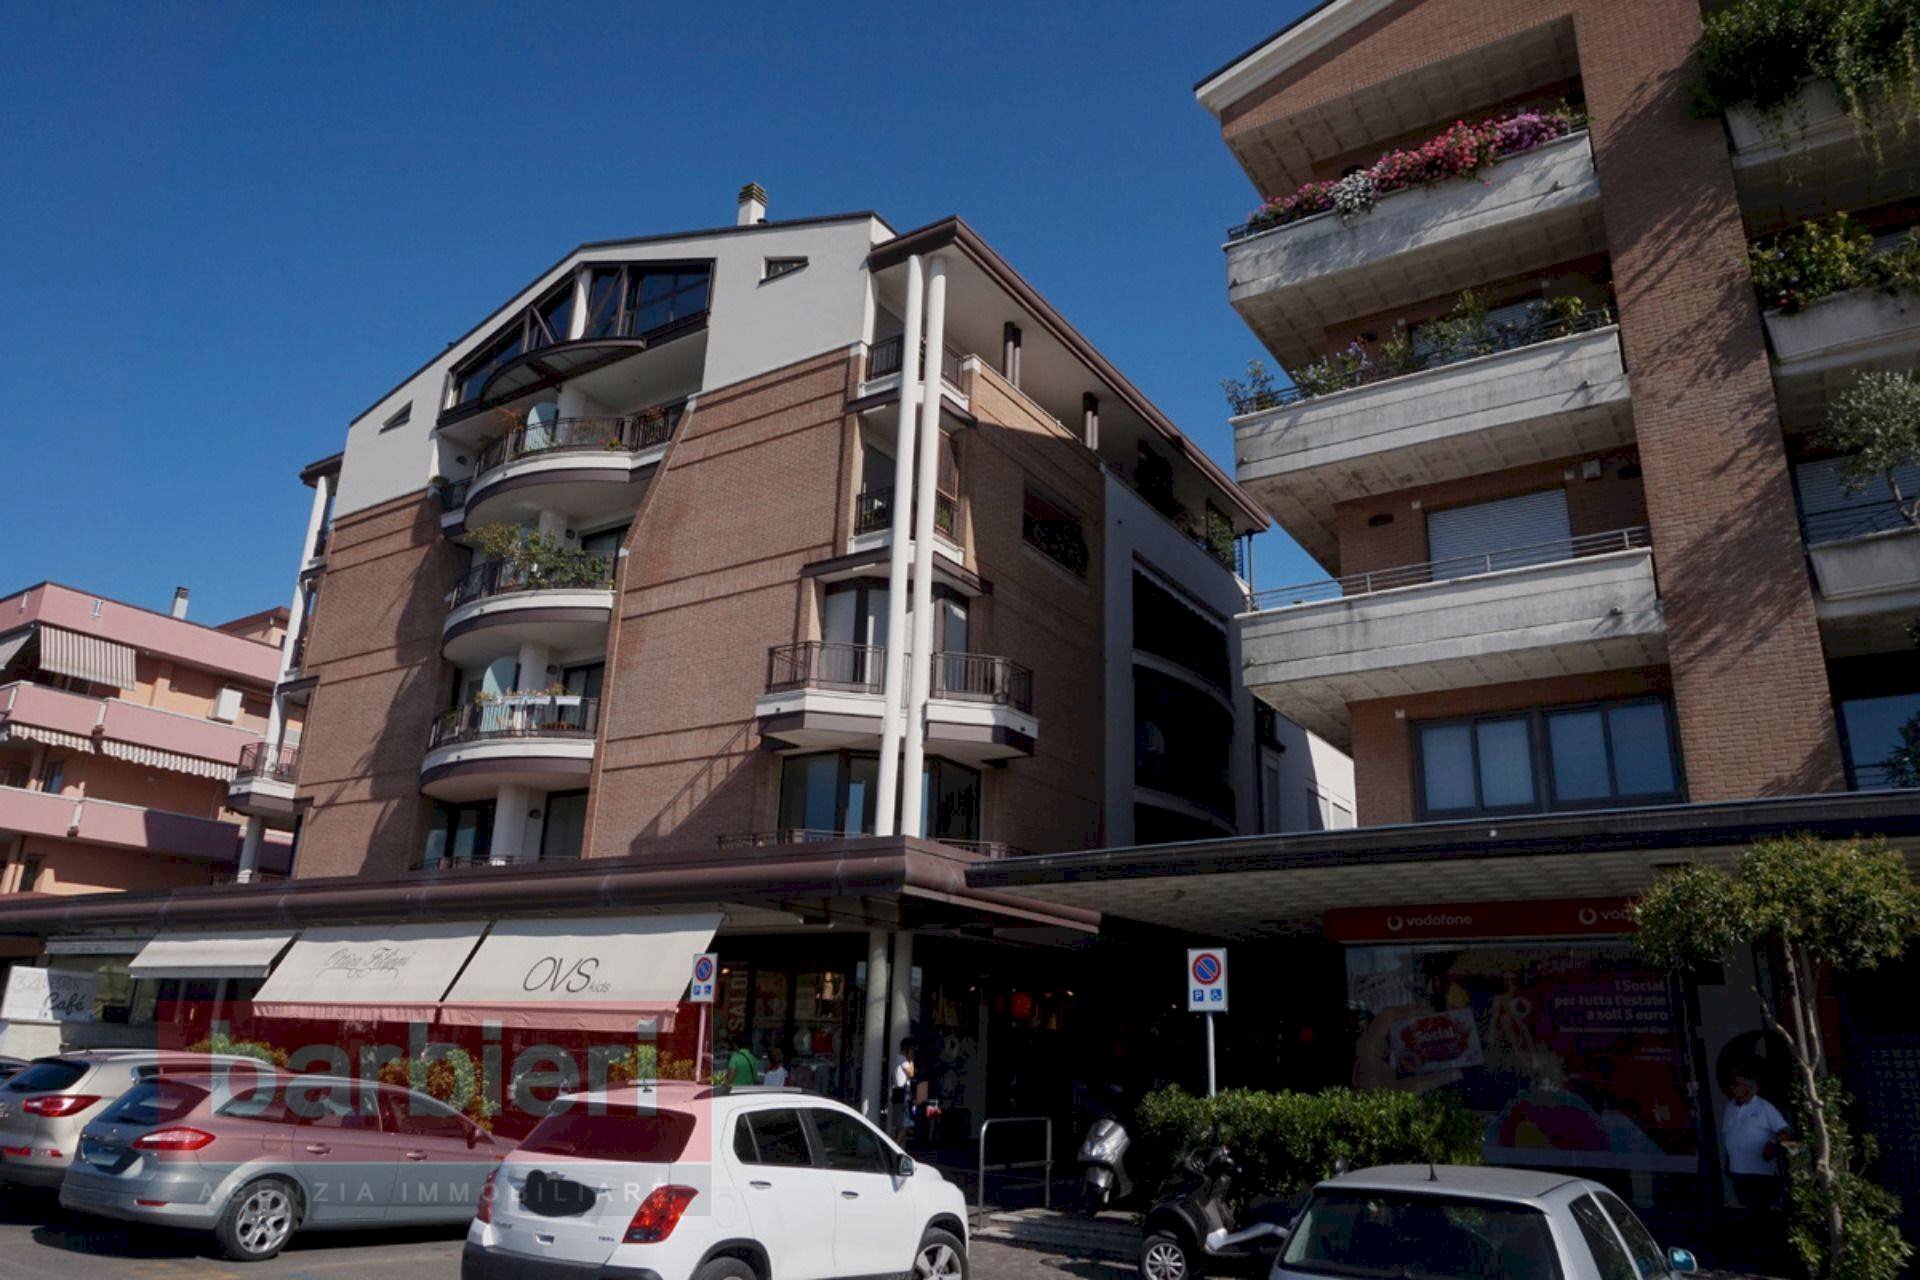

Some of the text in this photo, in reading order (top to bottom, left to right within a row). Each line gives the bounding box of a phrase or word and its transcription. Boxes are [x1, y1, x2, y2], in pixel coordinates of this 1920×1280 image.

[1405, 913, 1473, 927] vodafone
[523, 956, 599, 993] OVS
[1622, 979, 1667, 992] Social
[43, 991, 87, 1015] Café
[1554, 996, 1576, 1008] per
[1578, 995, 1613, 1007] tutta
[1597, 1008, 1623, 1021] soli
[1635, 1010, 1669, 1021] euro
[1413, 1026, 1456, 1041] Social
